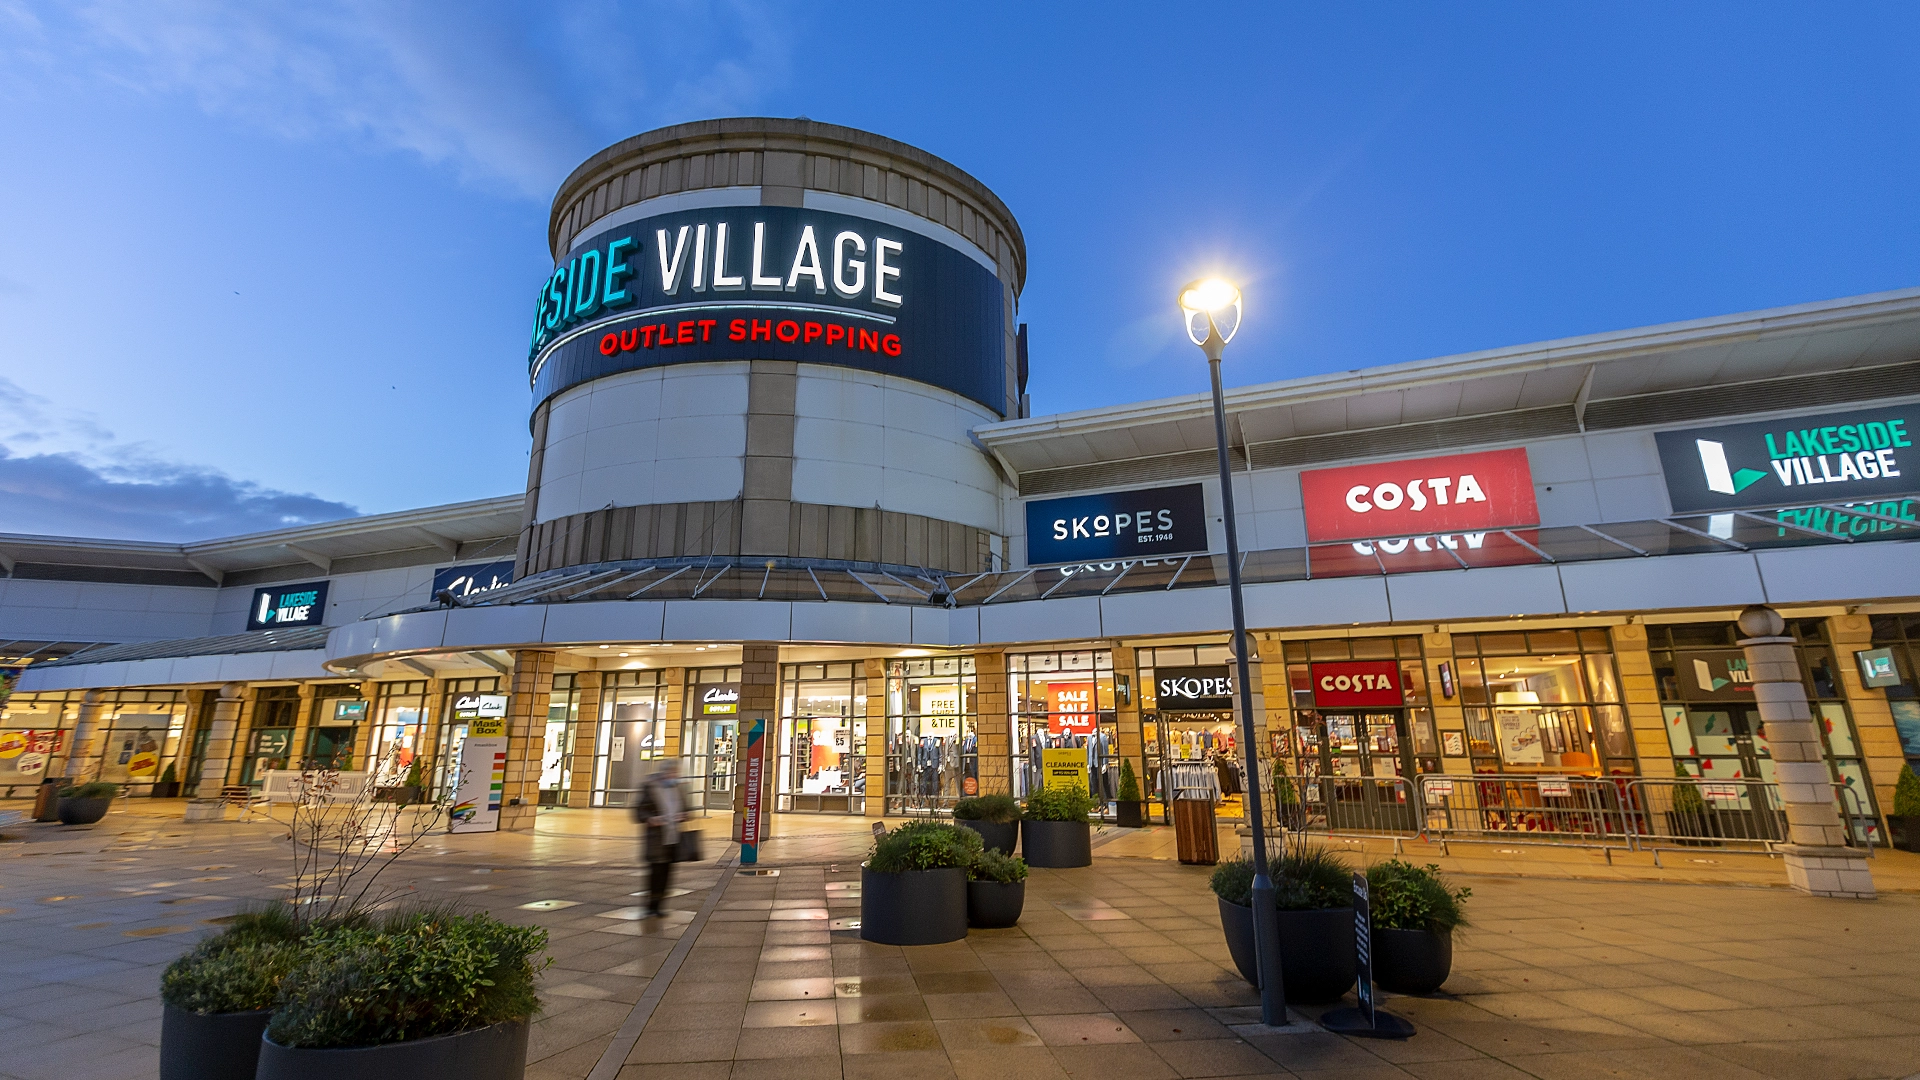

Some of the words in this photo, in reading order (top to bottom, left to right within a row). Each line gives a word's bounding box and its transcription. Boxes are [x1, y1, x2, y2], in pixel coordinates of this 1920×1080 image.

[655, 221, 904, 307] VILLAGE
[599, 319, 718, 357] OUTLET
[728, 318, 902, 358] SHOPPING
[1764, 418, 1912, 460] LAKESIDE
[1769, 448, 1901, 487] VILLAGE
[1345, 474, 1487, 513] COSTA
[1053, 508, 1174, 540] SKOPES
[1155, 532, 1174, 541] 1948
[278, 590, 319, 608] LAKESIDE
[275, 605, 312, 623] VILLAGE
[1320, 673, 1393, 694] COSTA
[703, 687, 739, 703] Clarks
[1057, 690, 1089, 702] SALE
[481, 702, 503, 710] Clarks
[931, 700, 956, 709] FREE
[473, 720, 502, 728] Mask
[1058, 715, 1090, 727] SALE
[1045, 761, 1086, 769] CLEARANCE
[745, 757, 760, 841] LAKESIDE-VILLAGE.CO.UK
